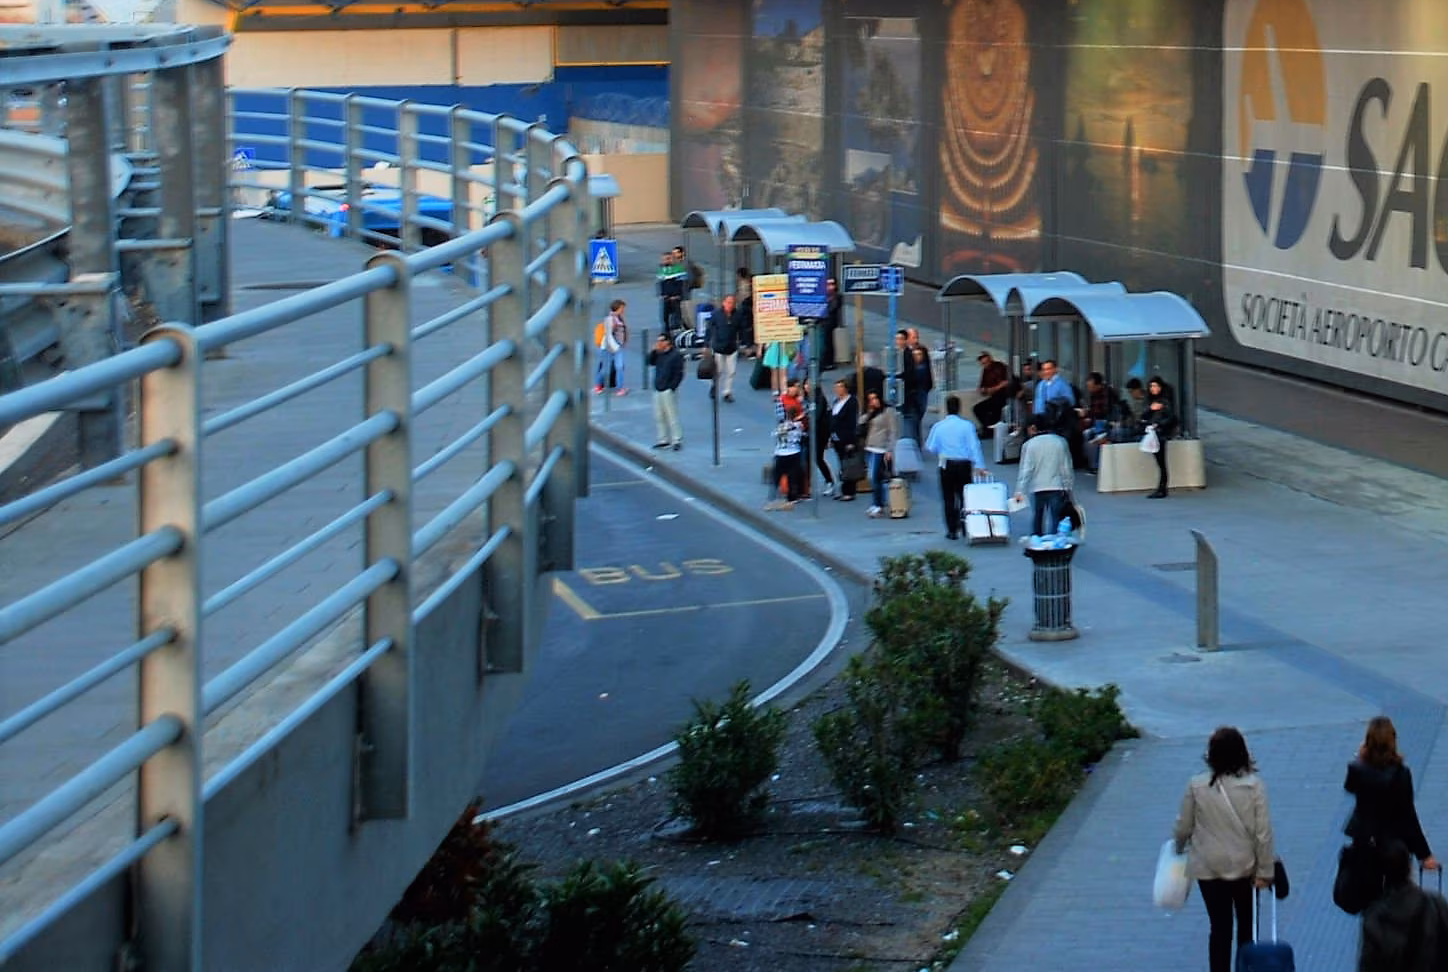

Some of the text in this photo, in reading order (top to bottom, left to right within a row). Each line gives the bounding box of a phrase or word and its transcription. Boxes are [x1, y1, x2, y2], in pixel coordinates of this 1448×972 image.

[1240, 292, 1307, 340] SOCIETÀ
[1308, 310, 1430, 366] AEROPORTO
[578, 558, 734, 585] BUS
